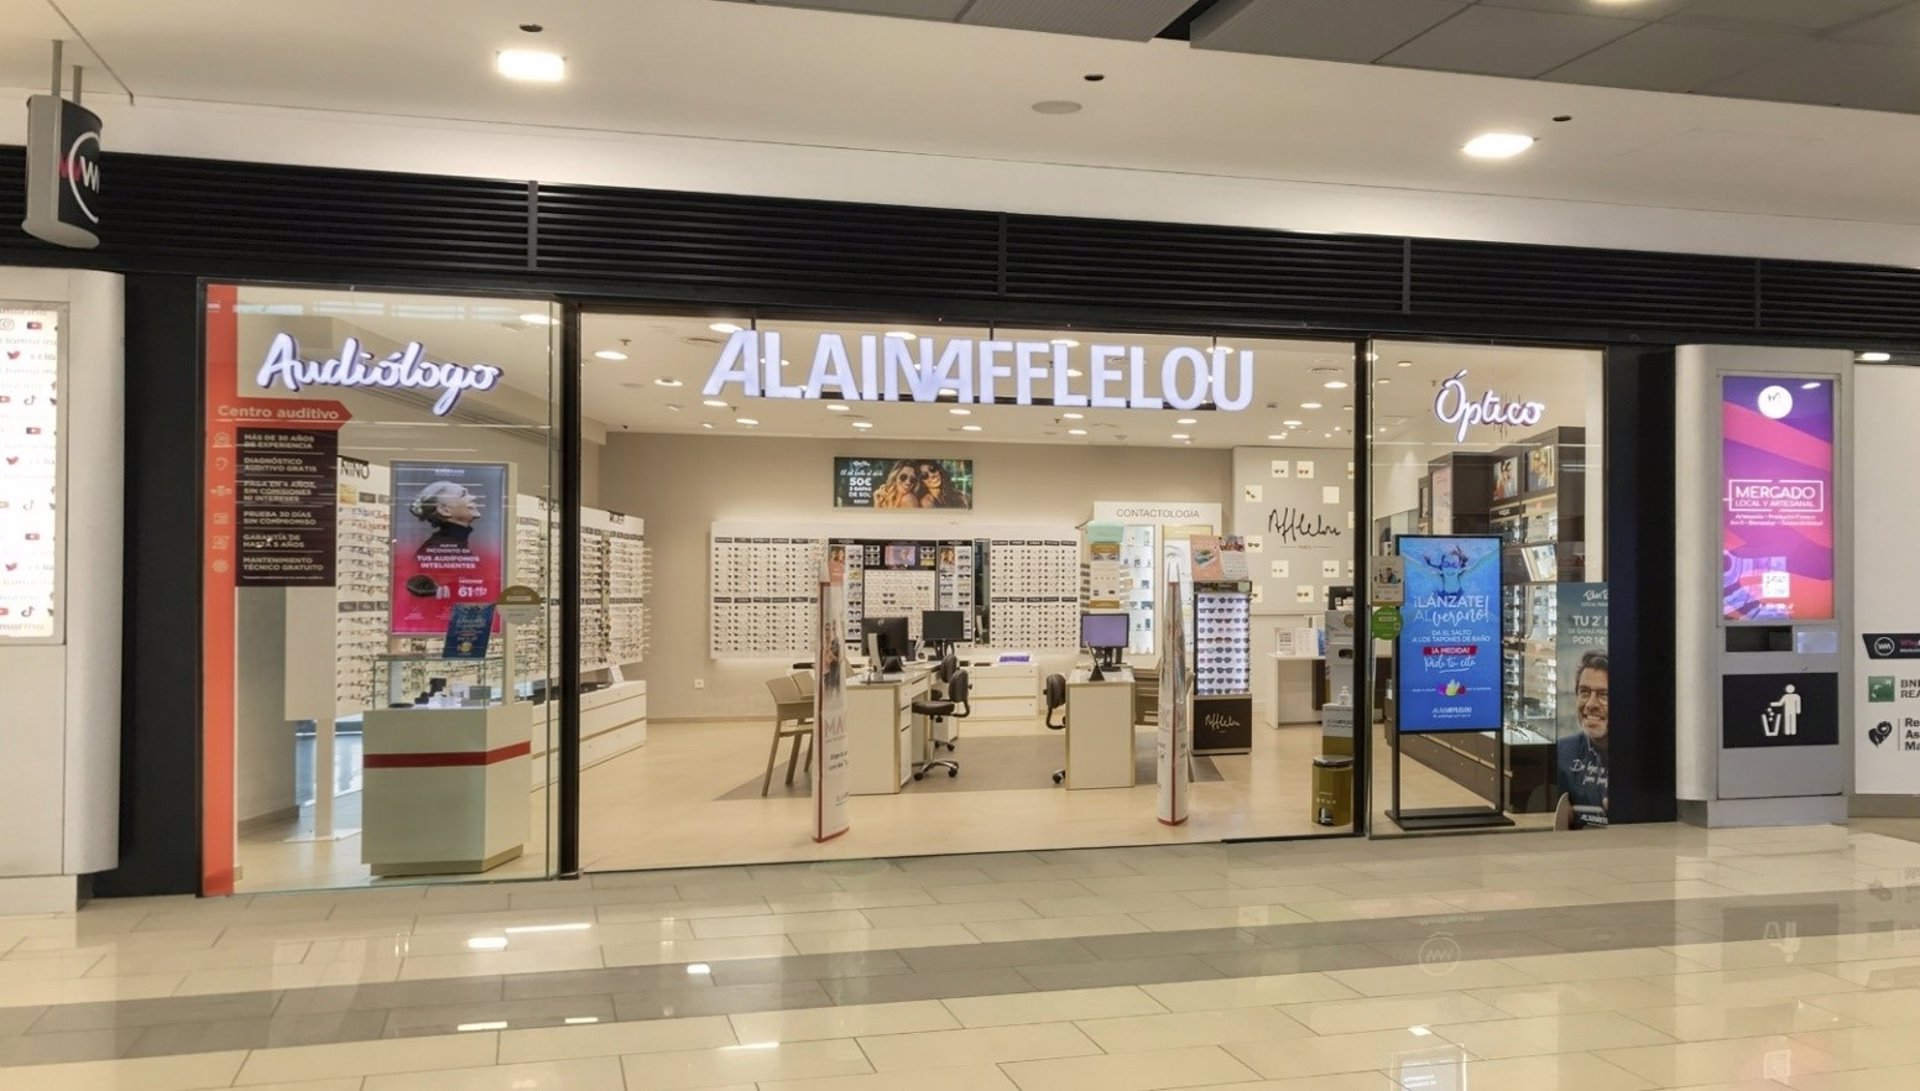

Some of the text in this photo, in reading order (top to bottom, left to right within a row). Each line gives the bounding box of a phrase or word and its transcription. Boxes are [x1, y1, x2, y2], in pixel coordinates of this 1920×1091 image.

[257, 332, 504, 416] Audiólogo
[1435, 369, 1546, 443] Óptico
[218, 405, 339, 420] Centro auditivo
[291, 434, 315, 443] AÑOS
[244, 456, 303, 465] DIAGNÓSTICO
[1735, 486, 1816, 499] MERCADO
[291, 510, 312, 518] DÍAS
[1115, 507, 1200, 519] CONTACTOLOGÍA
[259, 518, 317, 526] COMPROMISO
[281, 541, 305, 549] AÑOS
[1573, 615, 1590, 627] TU
[1572, 636, 1592, 645] POR
